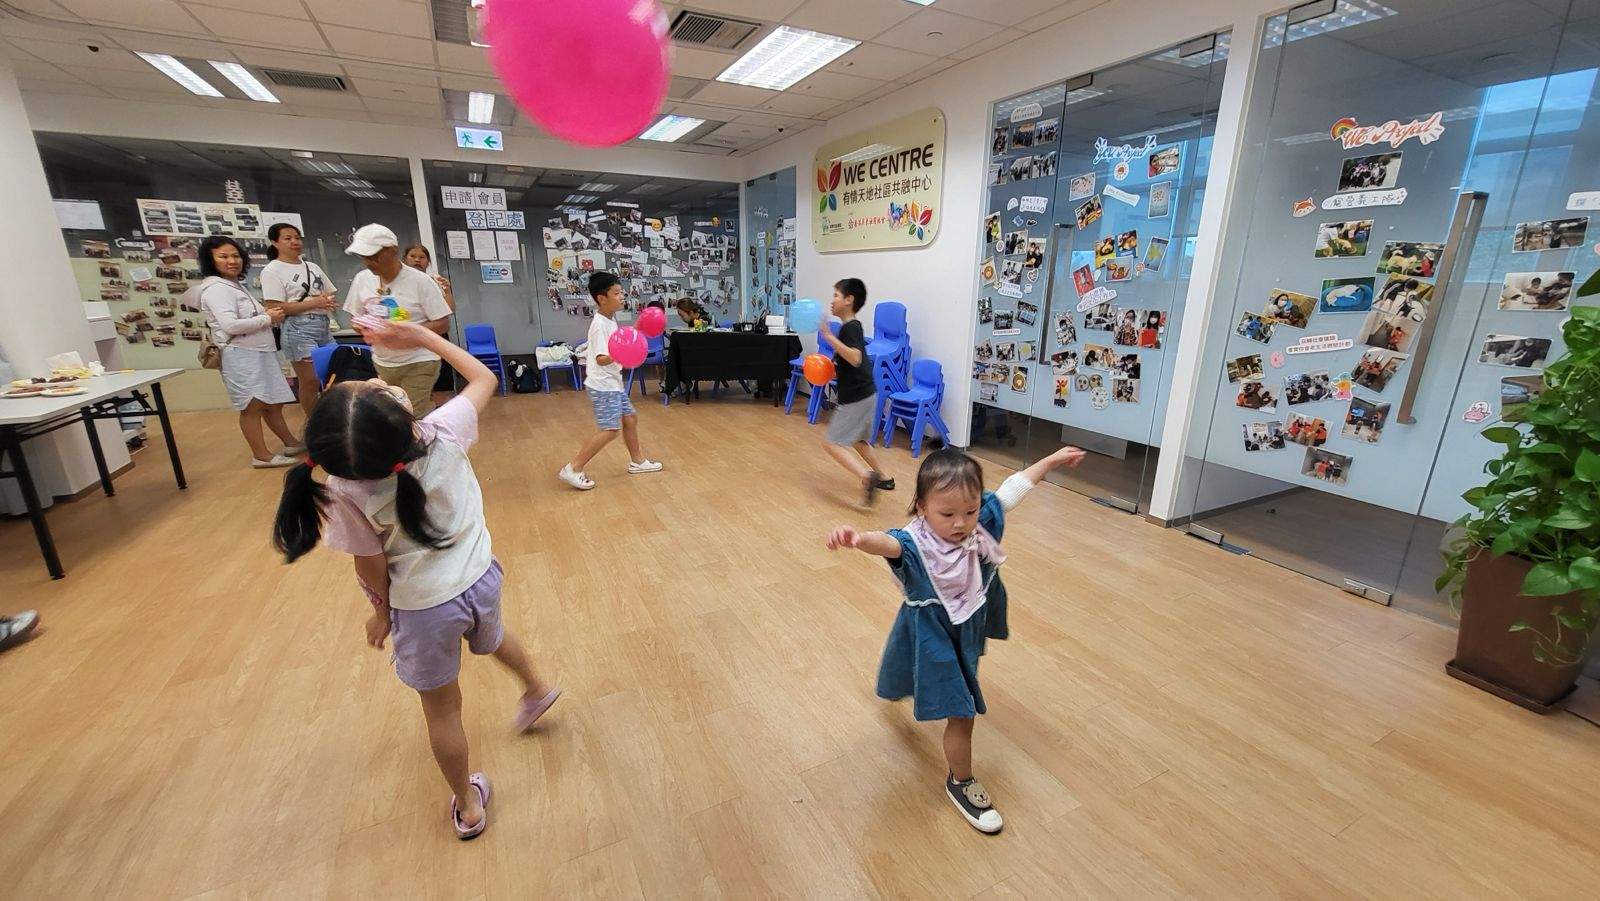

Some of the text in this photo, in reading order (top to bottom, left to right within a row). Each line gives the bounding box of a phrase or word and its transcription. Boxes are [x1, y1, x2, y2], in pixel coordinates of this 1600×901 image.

[844, 143, 934, 186] WE CENTRE
[444, 190, 504, 207] 申請會員
[843, 174, 933, 206] 有情天地社區共融中心
[467, 211, 523, 229] 登記處
